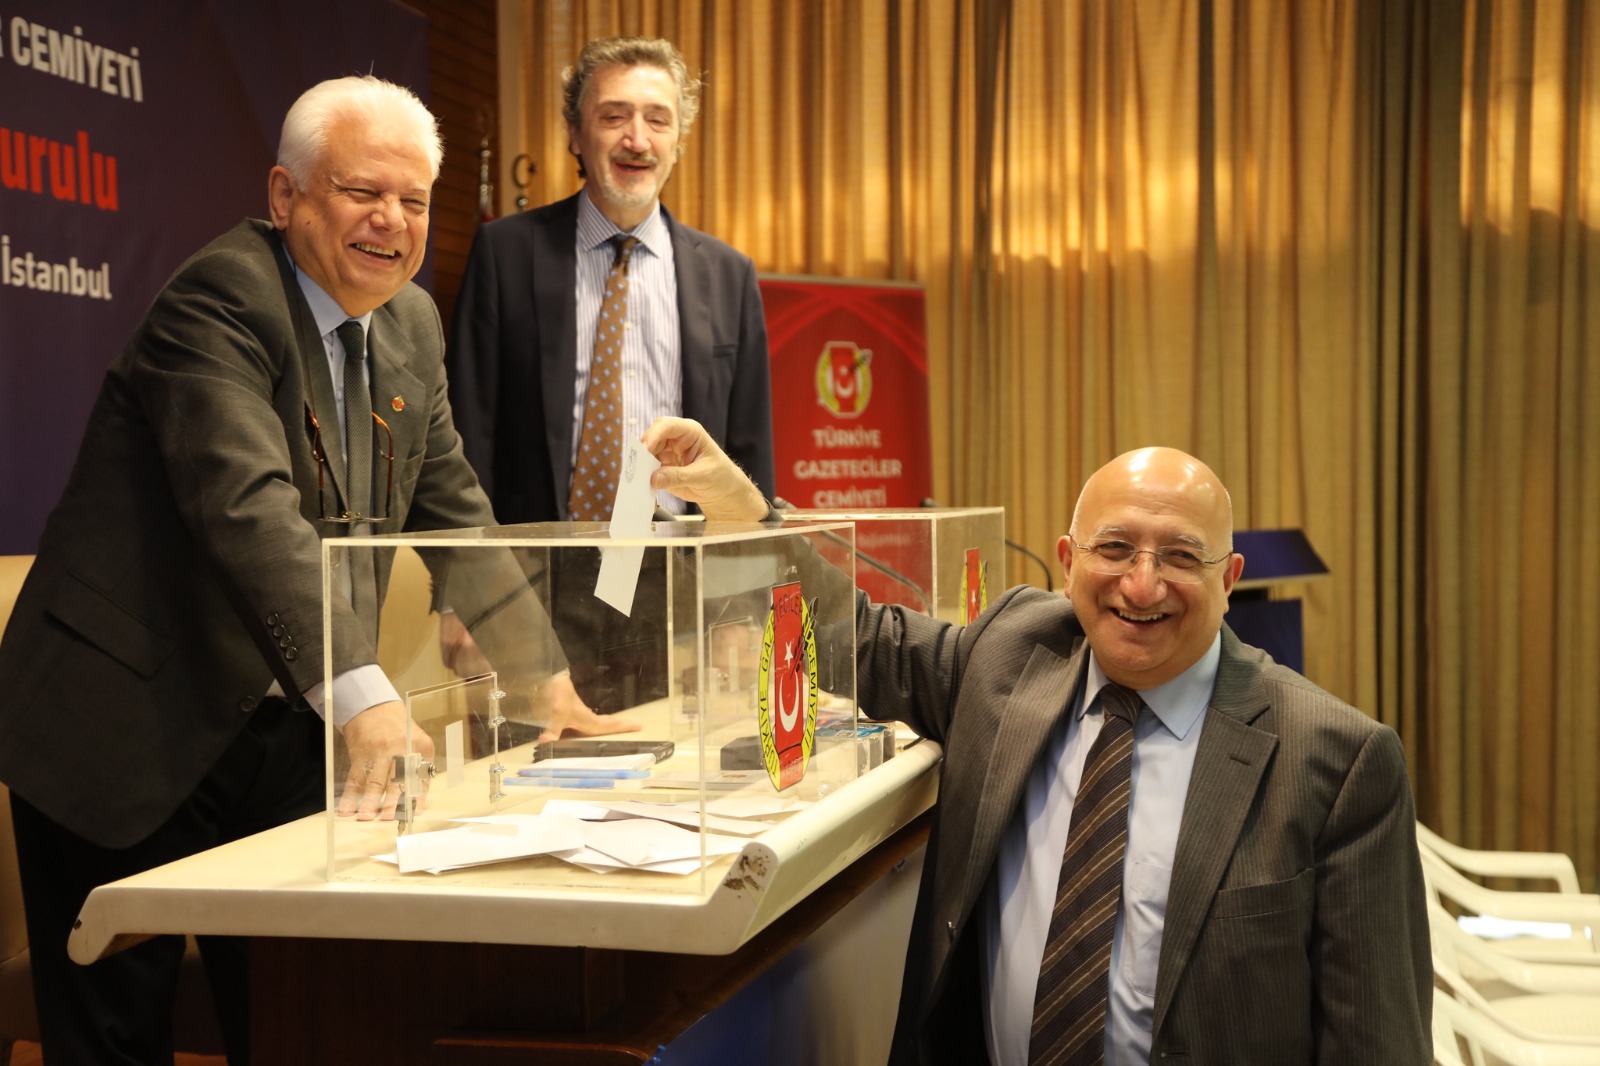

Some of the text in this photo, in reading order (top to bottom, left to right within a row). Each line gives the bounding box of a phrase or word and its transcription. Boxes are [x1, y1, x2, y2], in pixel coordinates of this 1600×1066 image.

[11, 16, 143, 102] CEMİYETİ
[0, 127, 118, 211] urulu
[2, 235, 112, 300] İstanbul
[812, 426, 881, 447] TÜRKİYE
[794, 456, 902, 479] GAZETECİLER
[813, 485, 886, 507] CEMİYETİ
